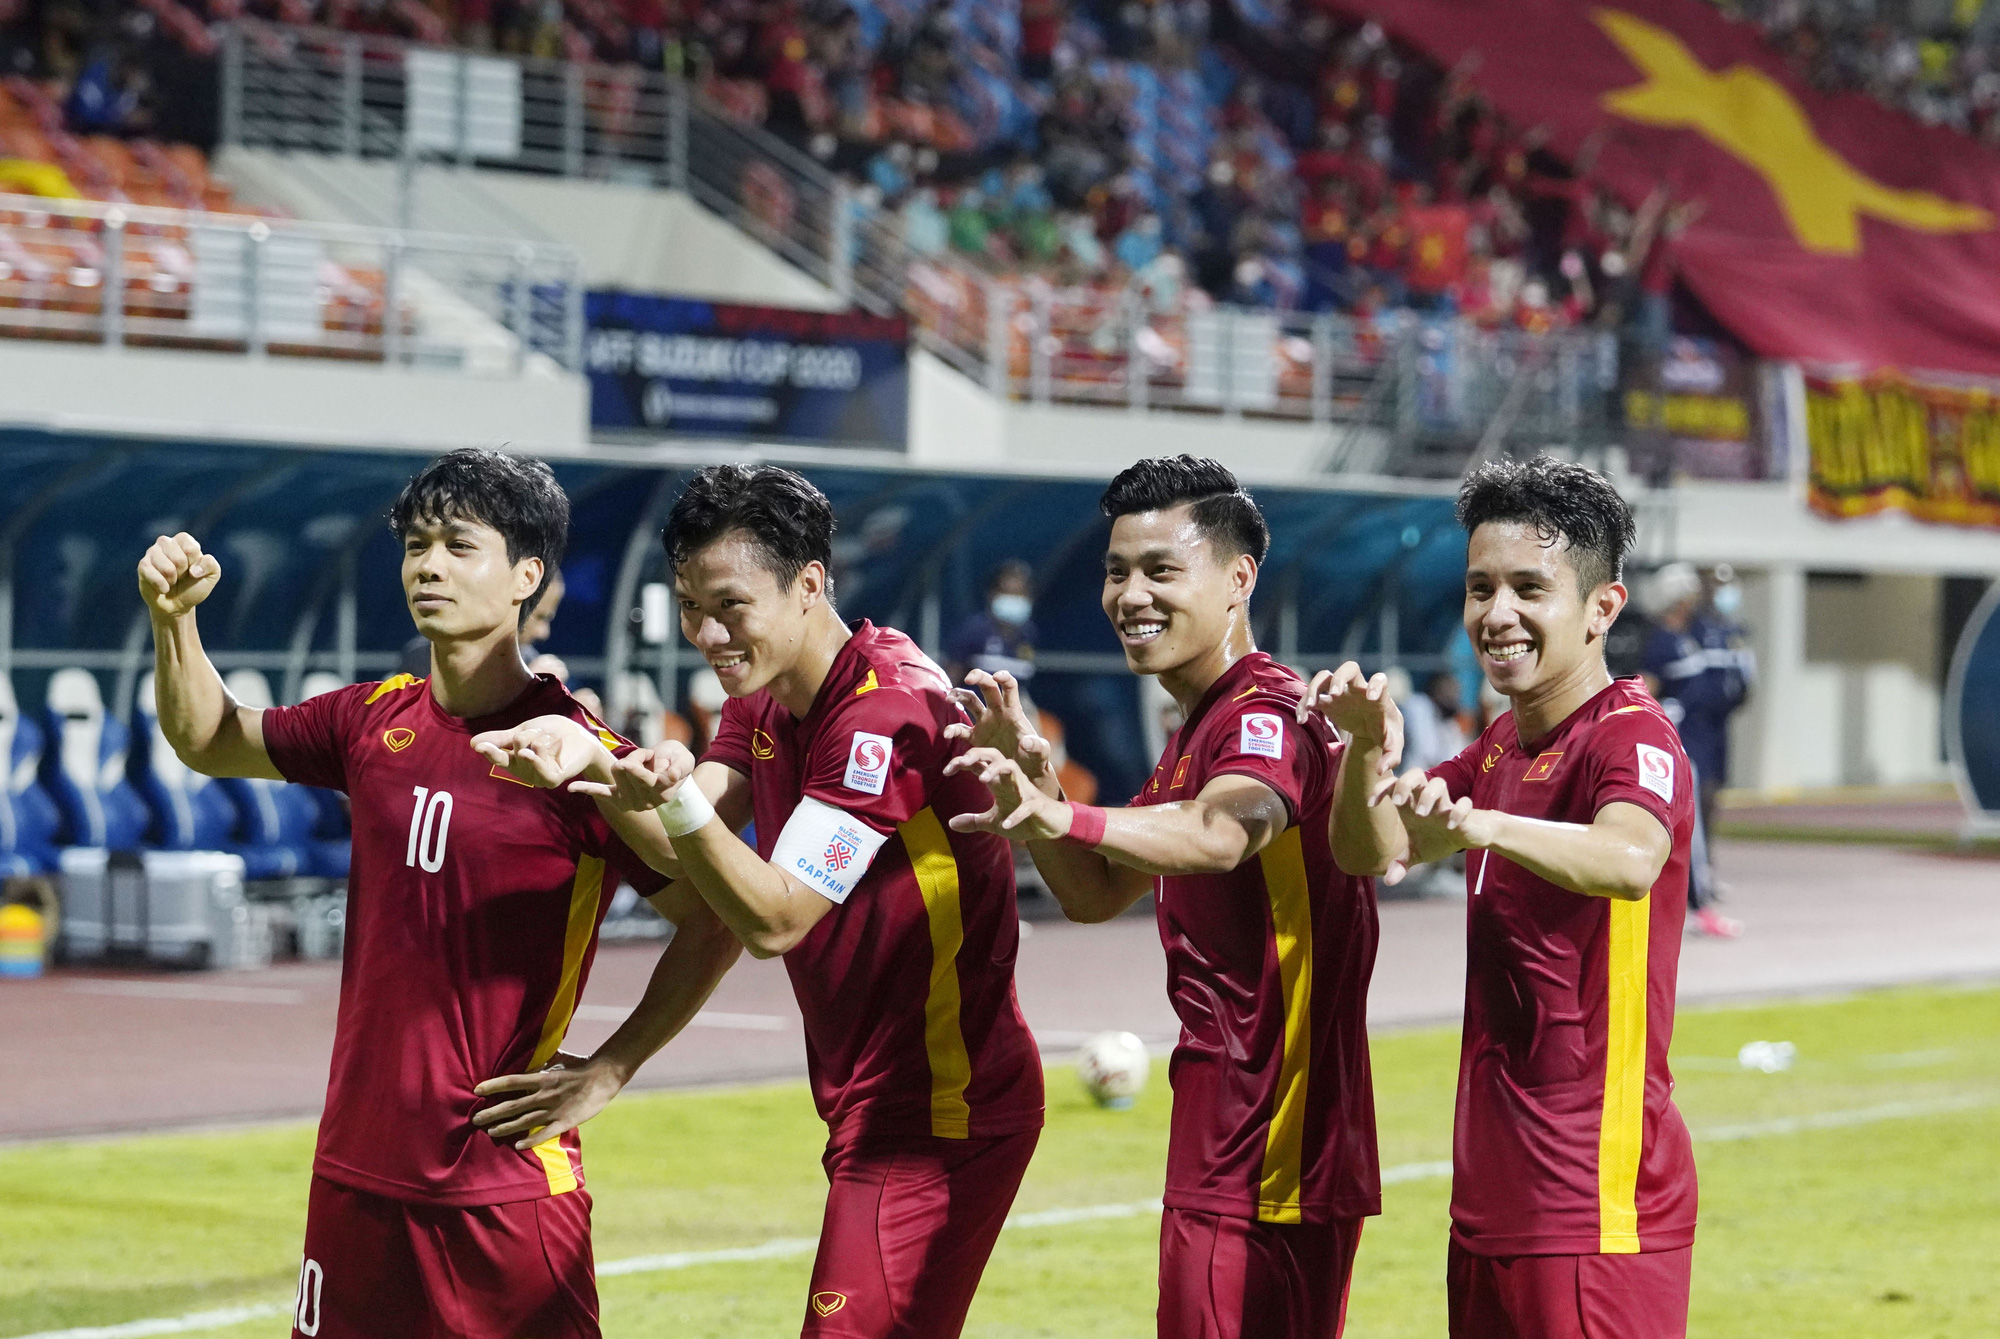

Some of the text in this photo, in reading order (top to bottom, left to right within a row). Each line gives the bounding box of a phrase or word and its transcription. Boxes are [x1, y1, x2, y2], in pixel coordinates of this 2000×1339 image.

[851, 774, 878, 783] STRONGER
[853, 770, 878, 778] EMERGING
[851, 779, 876, 787] TOGETHER
[405, 785, 454, 874] 10
[839, 826, 862, 843] SUZUKI
[796, 857, 846, 894] CAPTAIN
